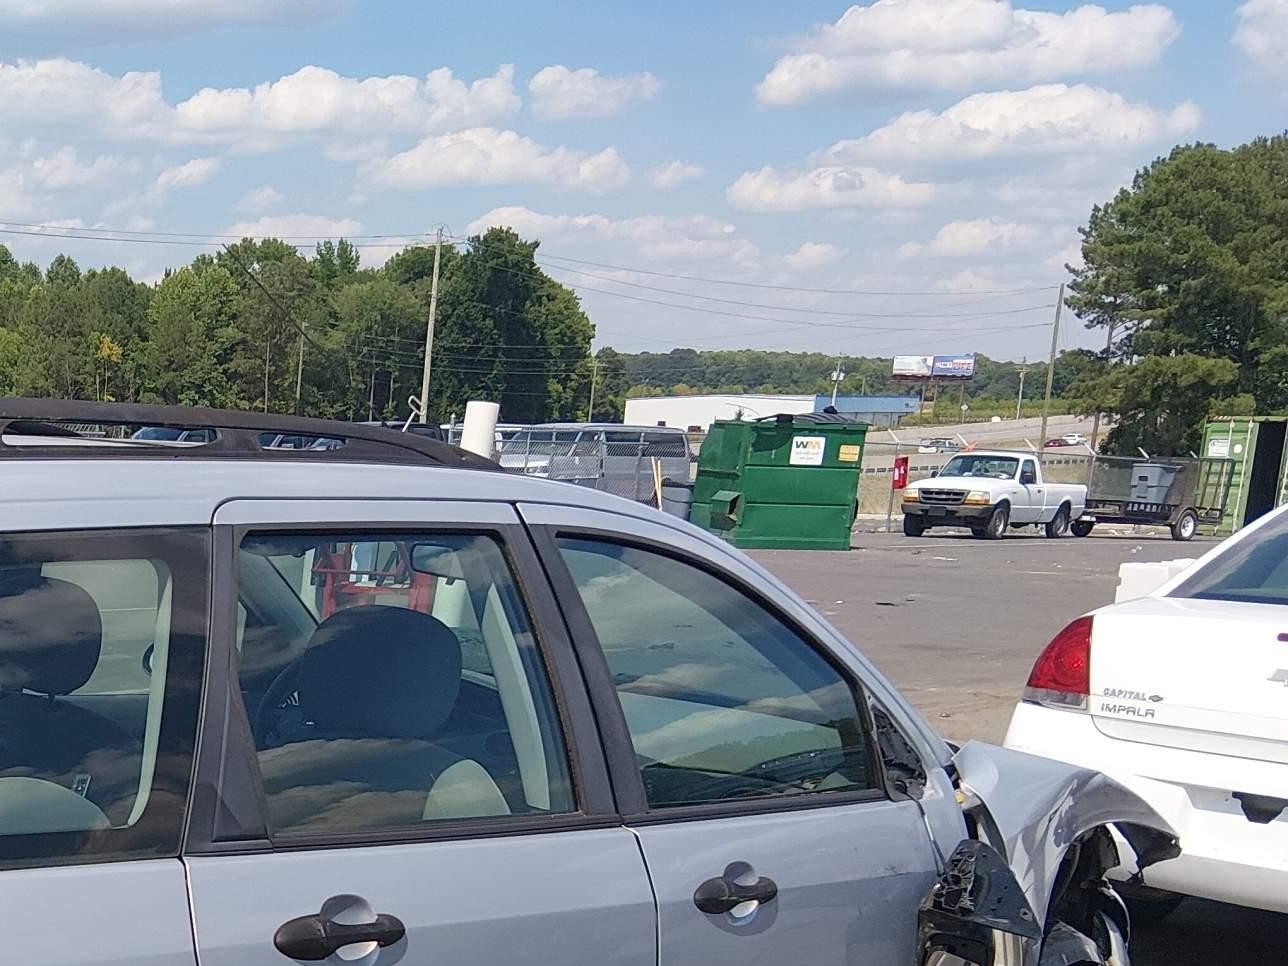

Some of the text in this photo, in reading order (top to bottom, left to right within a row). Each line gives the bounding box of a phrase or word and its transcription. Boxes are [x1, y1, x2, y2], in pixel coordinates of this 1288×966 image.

[795, 440, 821, 449] WM
[1103, 688, 1146, 701] CAPITAL
[1101, 703, 1155, 718] IMPALA
